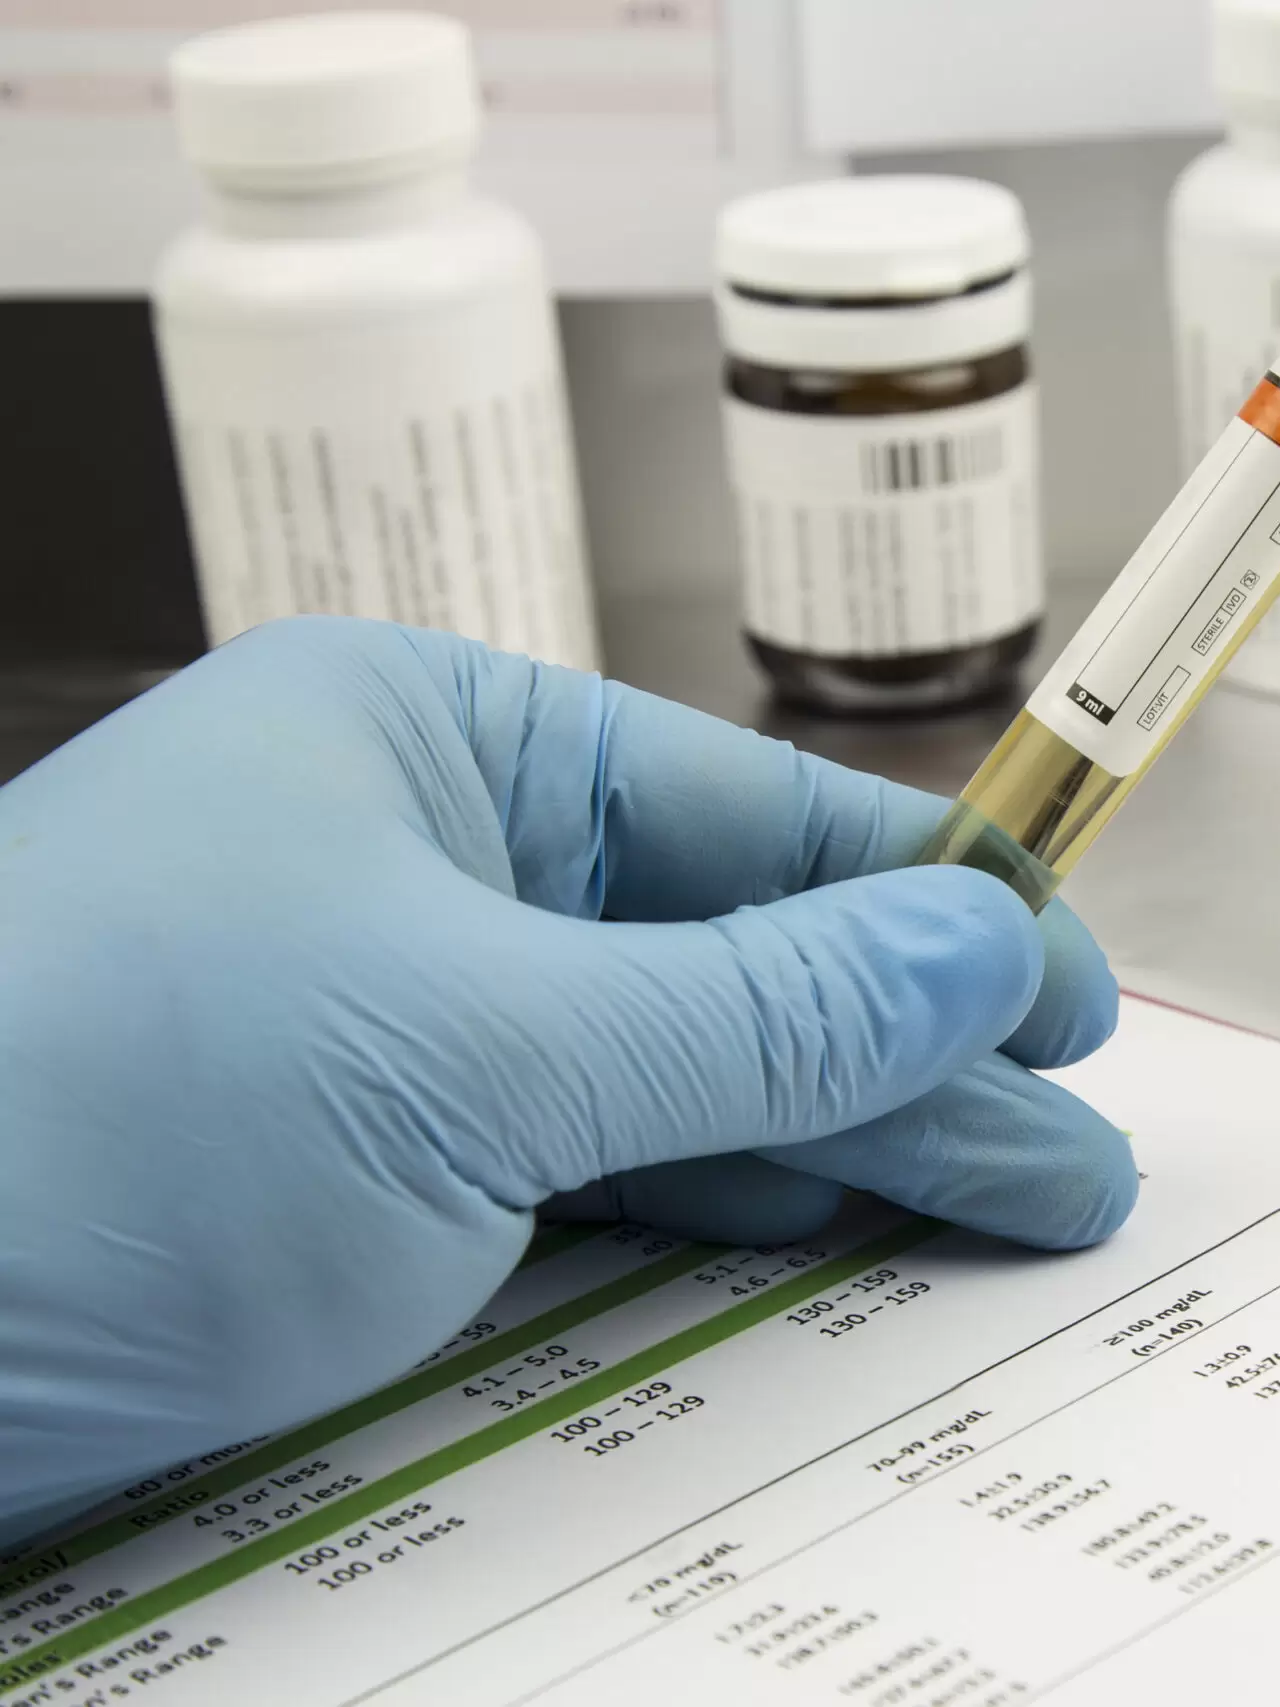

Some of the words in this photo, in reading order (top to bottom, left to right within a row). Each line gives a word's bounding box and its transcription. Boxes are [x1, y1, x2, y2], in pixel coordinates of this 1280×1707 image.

[1225, 594, 1241, 611] IVD
[1197, 616, 1224, 651] STERILE
[1076, 691, 1088, 702] 9
[1085, 699, 1105, 716] ml
[642, 1240, 674, 1257] 40
[694, 1264, 738, 1285] 5.1
[729, 1276, 770, 1297] 4.6
[786, 1249, 826, 1269] 6.5
[786, 1300, 834, 1326] 130
[852, 1269, 899, 1293] 159
[819, 1313, 867, 1338] 130
[884, 1281, 931, 1306] 159
[1102, 1318, 1154, 1347] ≥100
[1155, 1288, 1213, 1321] mg/dL
[461, 1322, 497, 1341] 59
[1130, 1318, 1205, 1357] (n=140)
[461, 1376, 505, 1399] 4.1
[524, 1345, 568, 1367] 5.0
[491, 1388, 537, 1412] 3.4
[560, 1357, 601, 1381] 4.5
[1192, 1344, 1252, 1378] 1.3±0.9
[551, 1416, 601, 1443] 100
[622, 1381, 673, 1408] 129
[584, 1430, 635, 1457] 100
[655, 1395, 706, 1421] 129
[929, 1407, 993, 1444] mg/dL
[124, 1479, 163, 1500] 60
[167, 1463, 195, 1482] or
[895, 1443, 976, 1484] (n=155)
[127, 1490, 210, 1528] Ratio
[193, 1503, 238, 1528] 4.0
[242, 1486, 271, 1505] or
[267, 1459, 331, 1489] less
[221, 1518, 270, 1543] 3.3
[273, 1502, 302, 1520] or
[301, 1474, 364, 1503] less
[284, 1546, 340, 1575] 100
[343, 1529, 373, 1549] or
[369, 1502, 432, 1532] less
[317, 1561, 373, 1591] 100
[377, 1545, 405, 1564] or
[402, 1516, 466, 1547] less
[0, 1583, 76, 1625] ange
[30, 1587, 128, 1635] Range
[74, 1630, 173, 1679] Range
[128, 1635, 228, 1685] Range
